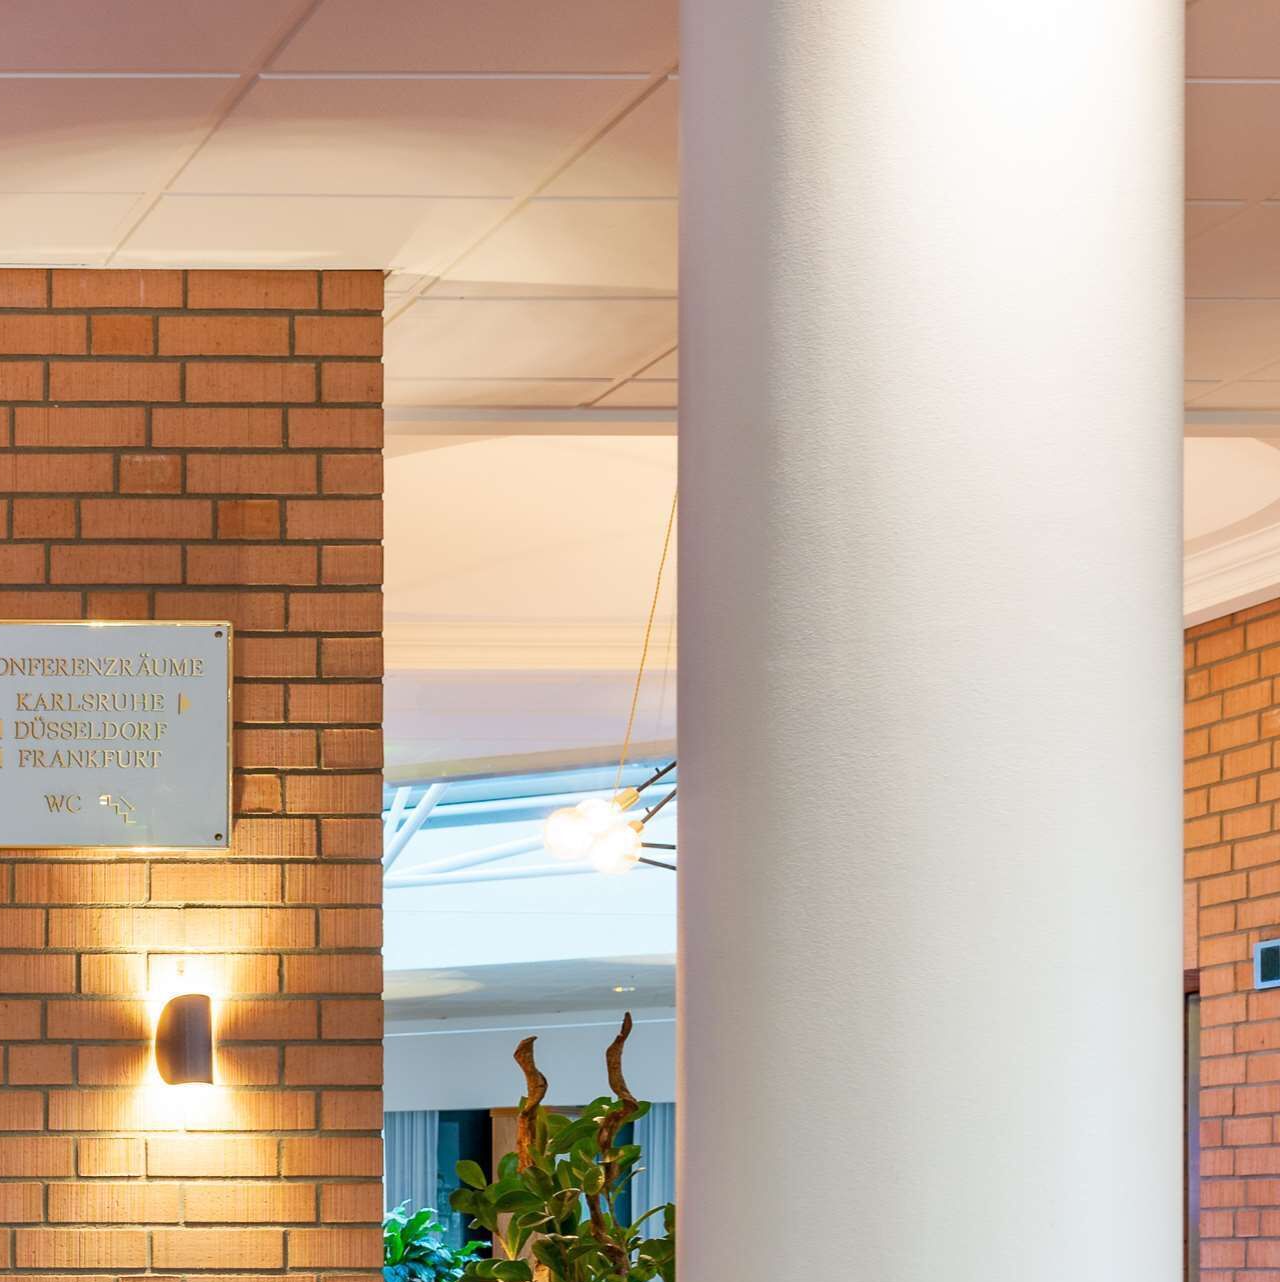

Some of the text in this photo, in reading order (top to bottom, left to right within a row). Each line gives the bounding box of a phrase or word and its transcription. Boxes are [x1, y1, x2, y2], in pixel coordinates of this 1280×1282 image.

[16, 693, 165, 712] KARLSRUHE
[14, 717, 168, 740] DÜSSELDORF
[18, 750, 162, 768] FRANKFURT
[44, 795, 81, 813] WC
